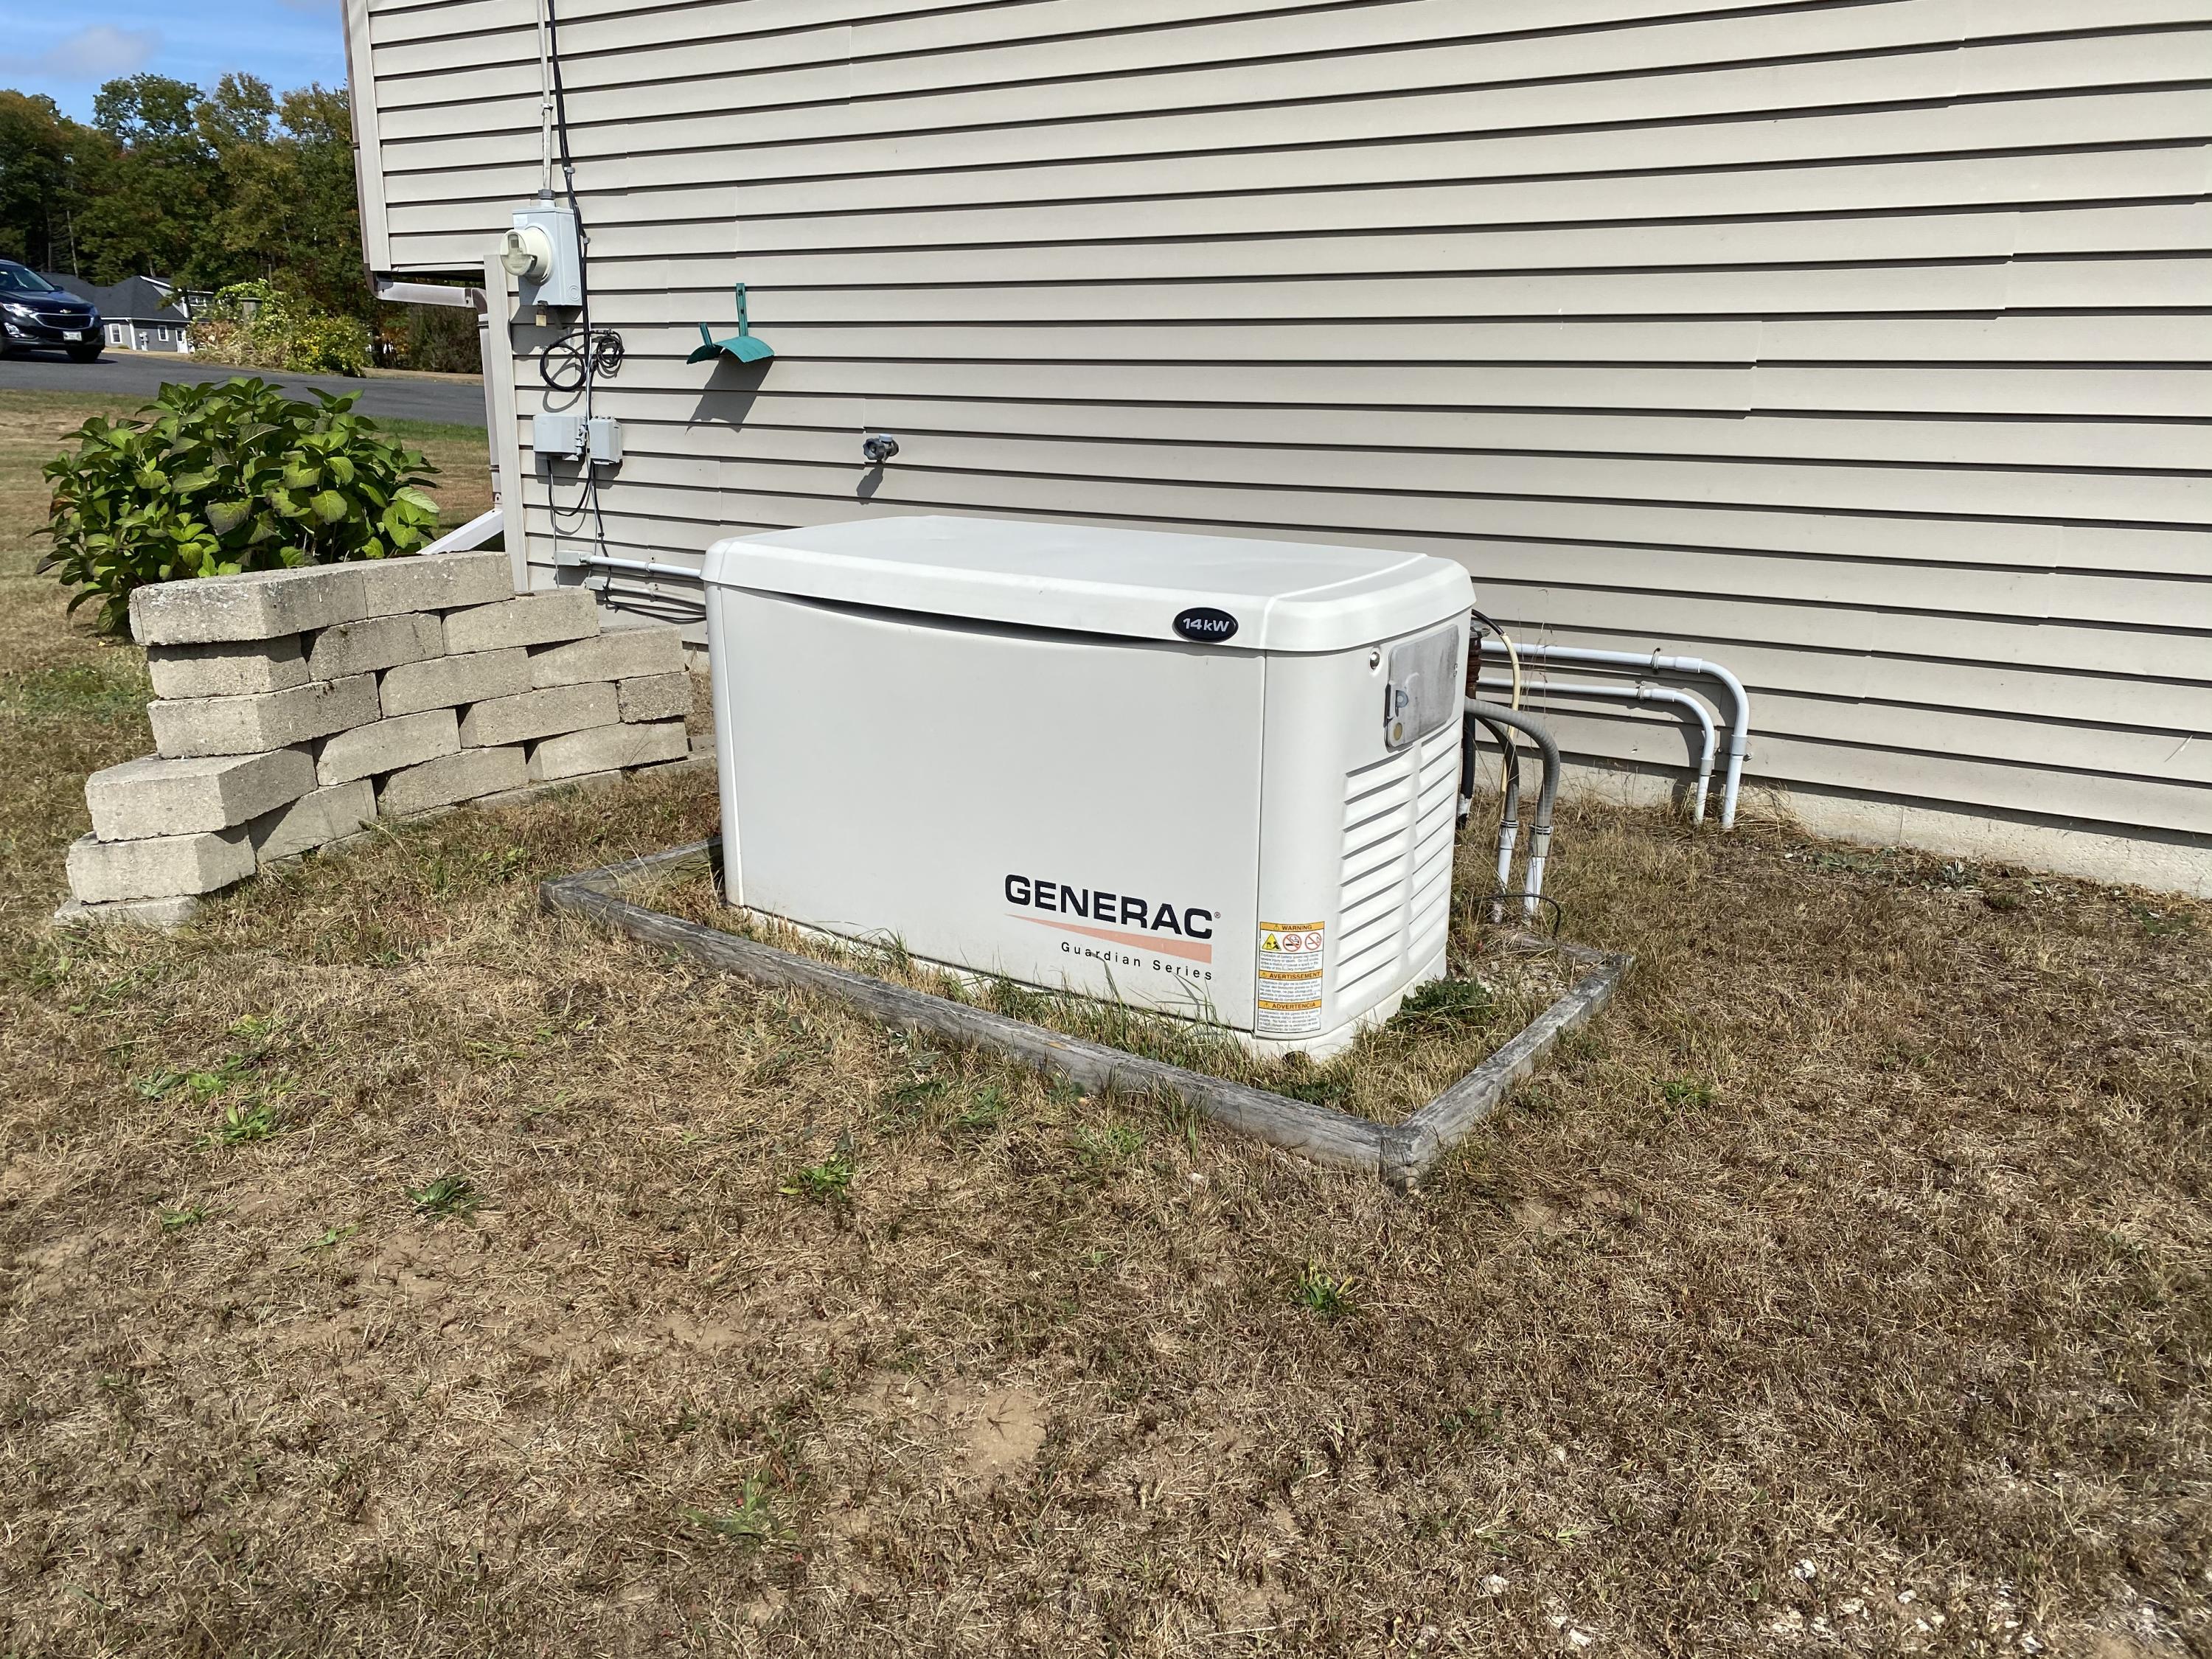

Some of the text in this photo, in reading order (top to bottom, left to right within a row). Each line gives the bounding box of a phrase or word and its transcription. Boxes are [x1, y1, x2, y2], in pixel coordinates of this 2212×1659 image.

[1183, 618, 1230, 632] 14kW
[1061, 942, 1212, 980] Guardian Series
